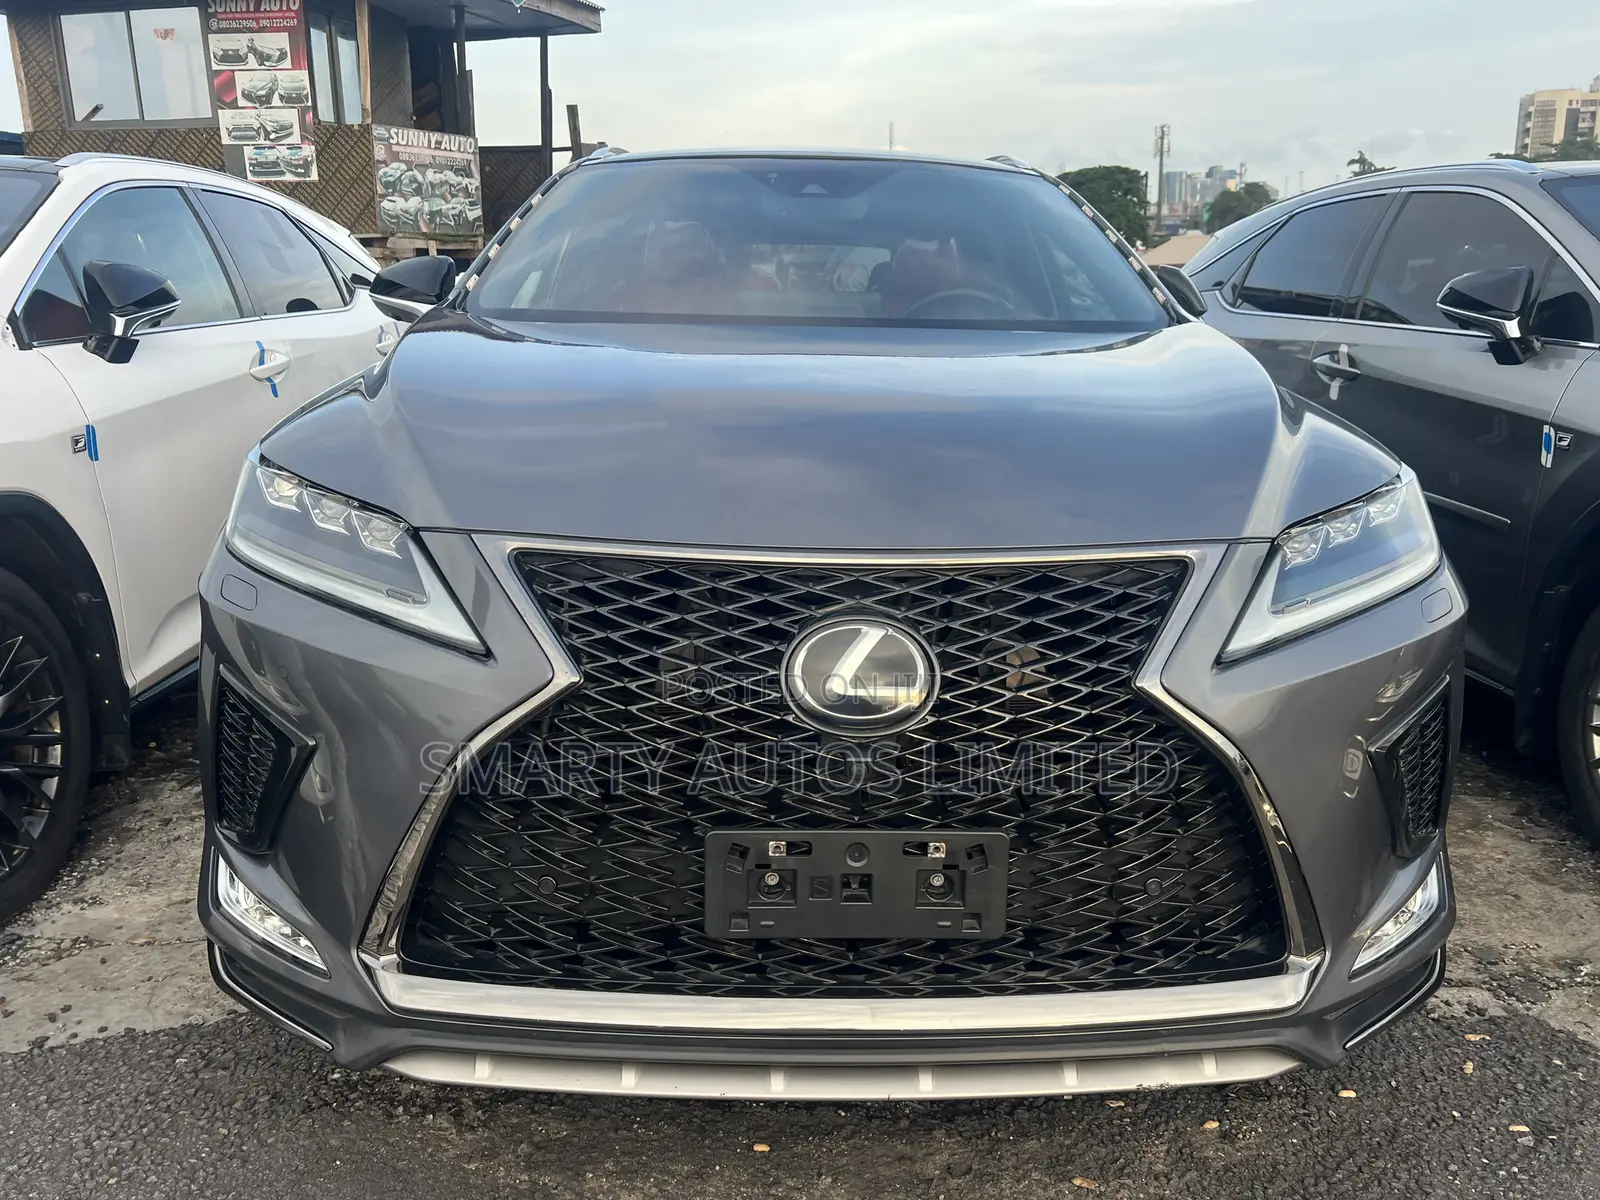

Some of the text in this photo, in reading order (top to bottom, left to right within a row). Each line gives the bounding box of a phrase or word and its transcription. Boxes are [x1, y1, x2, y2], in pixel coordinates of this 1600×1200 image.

[207, 0, 300, 12] SUNNY AUTO
[389, 128, 475, 153] SUNNY AUTO
